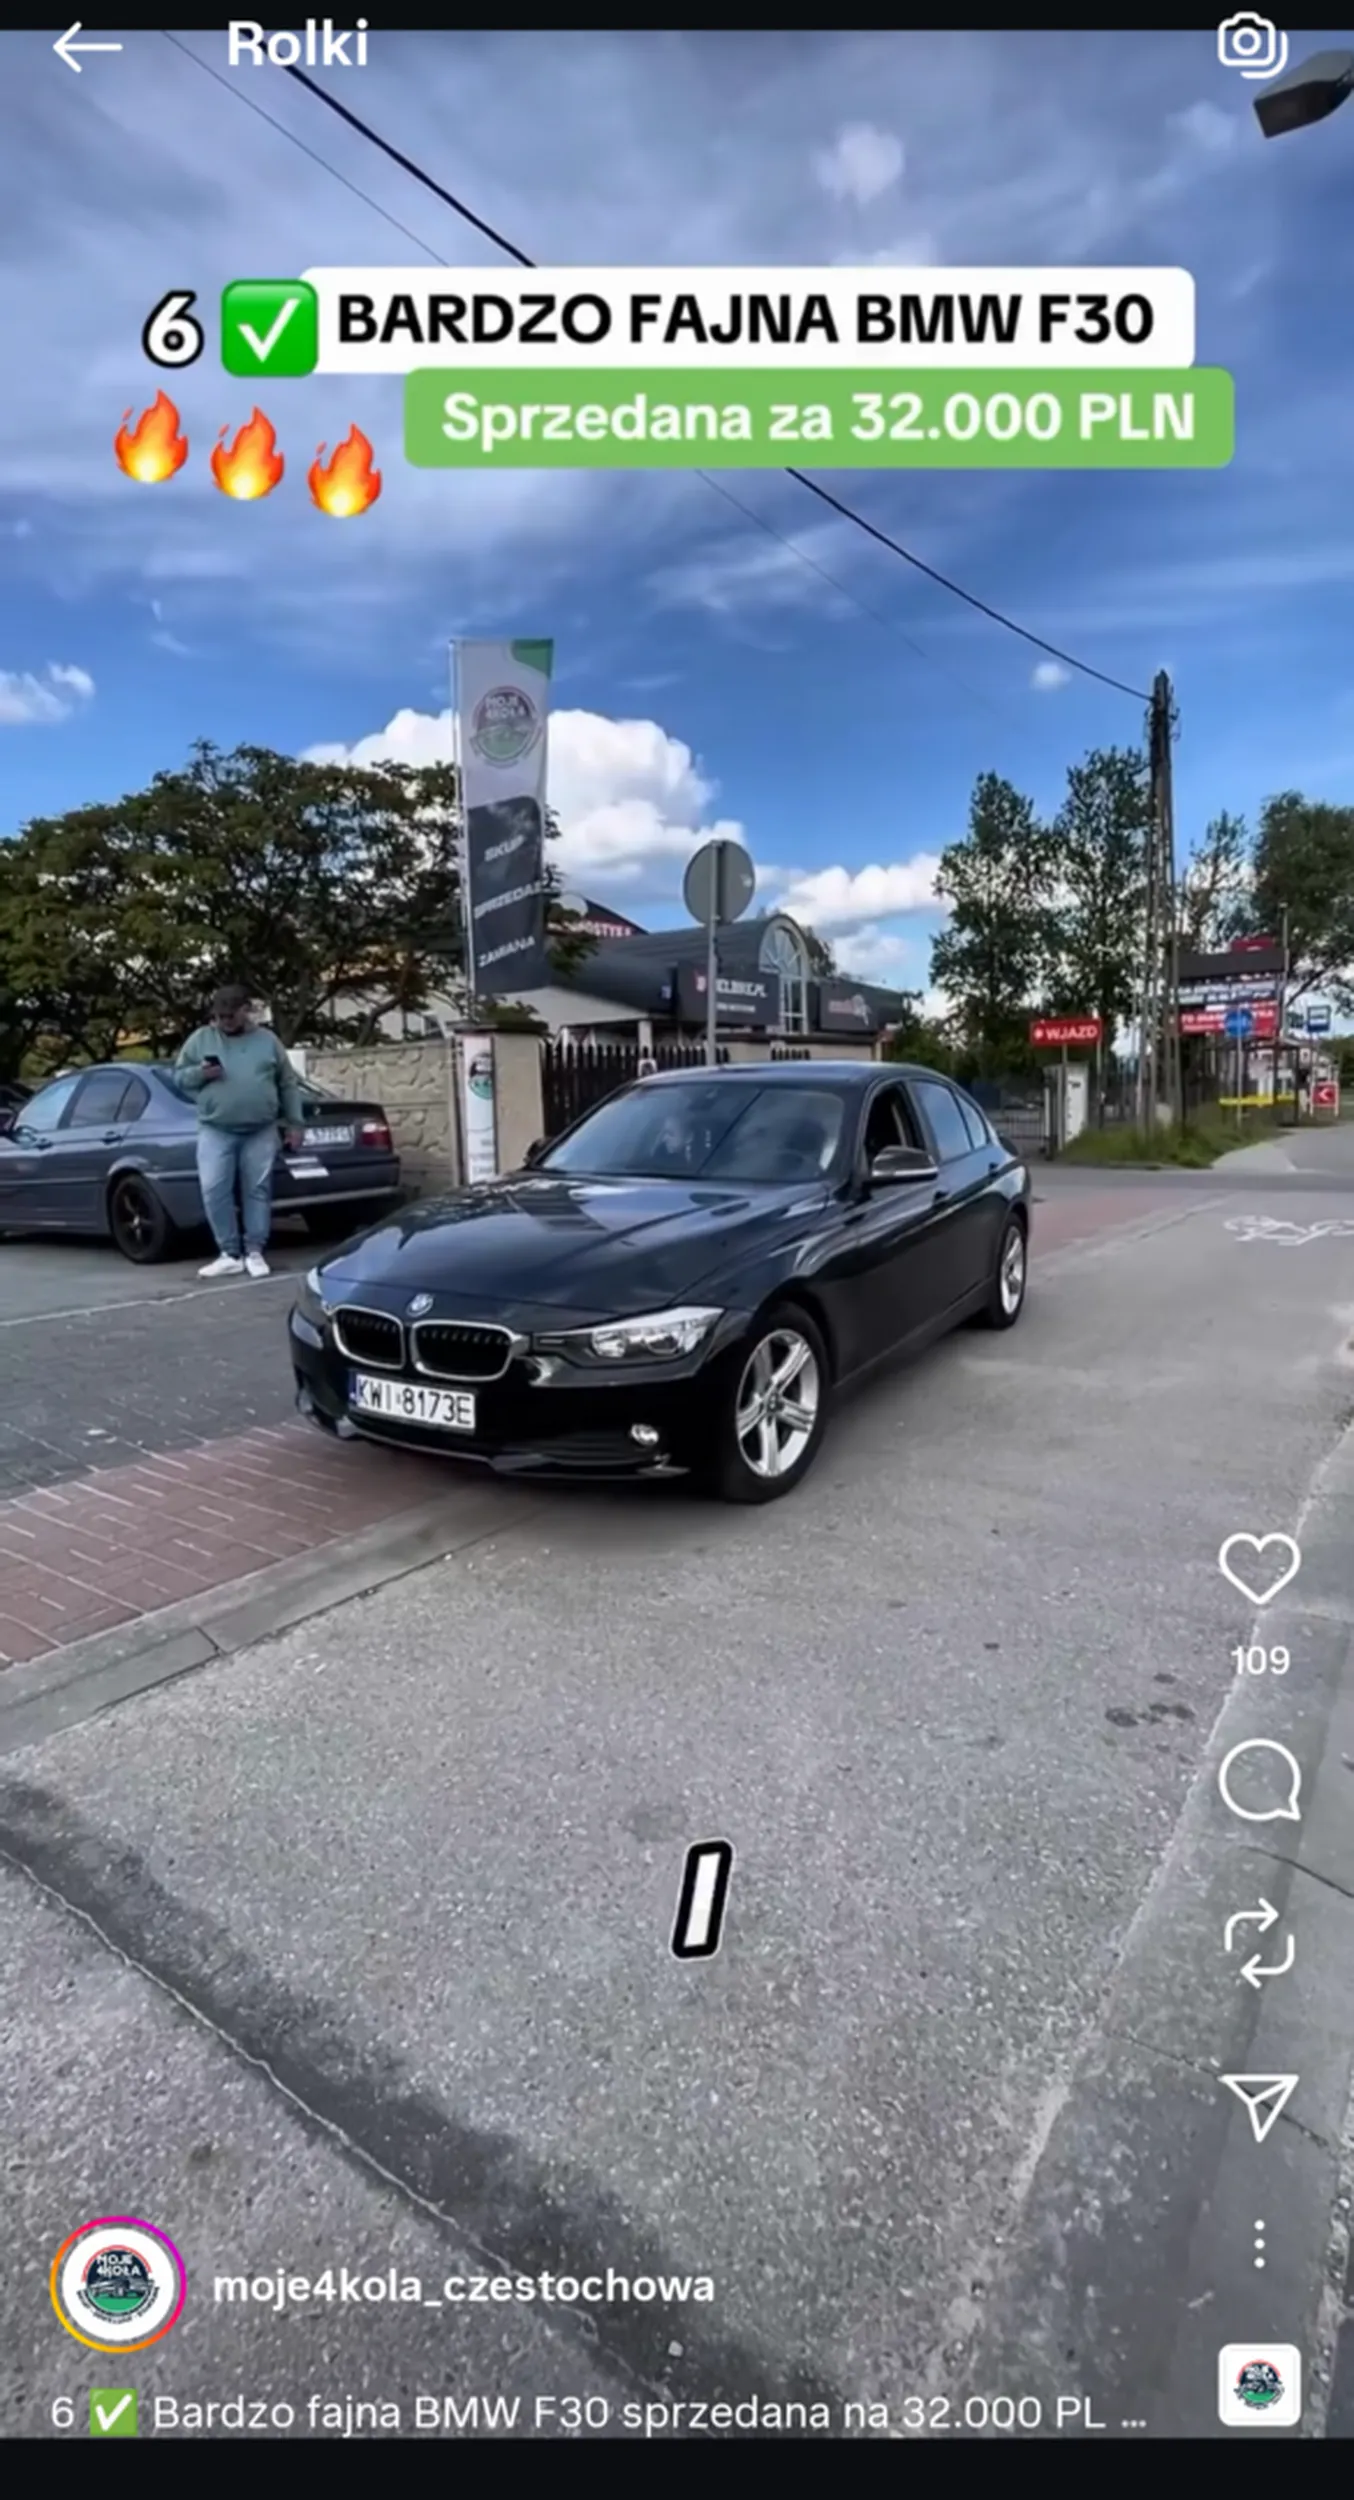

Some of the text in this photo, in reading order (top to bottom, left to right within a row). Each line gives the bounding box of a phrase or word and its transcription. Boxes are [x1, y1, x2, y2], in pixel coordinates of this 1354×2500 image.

[484, 834, 525, 862] SKUP
[478, 935, 536, 968] ZAMIANA
[1046, 1025, 1098, 1041] WJAZD
[357, 1377, 472, 1425] KWI 8173E
